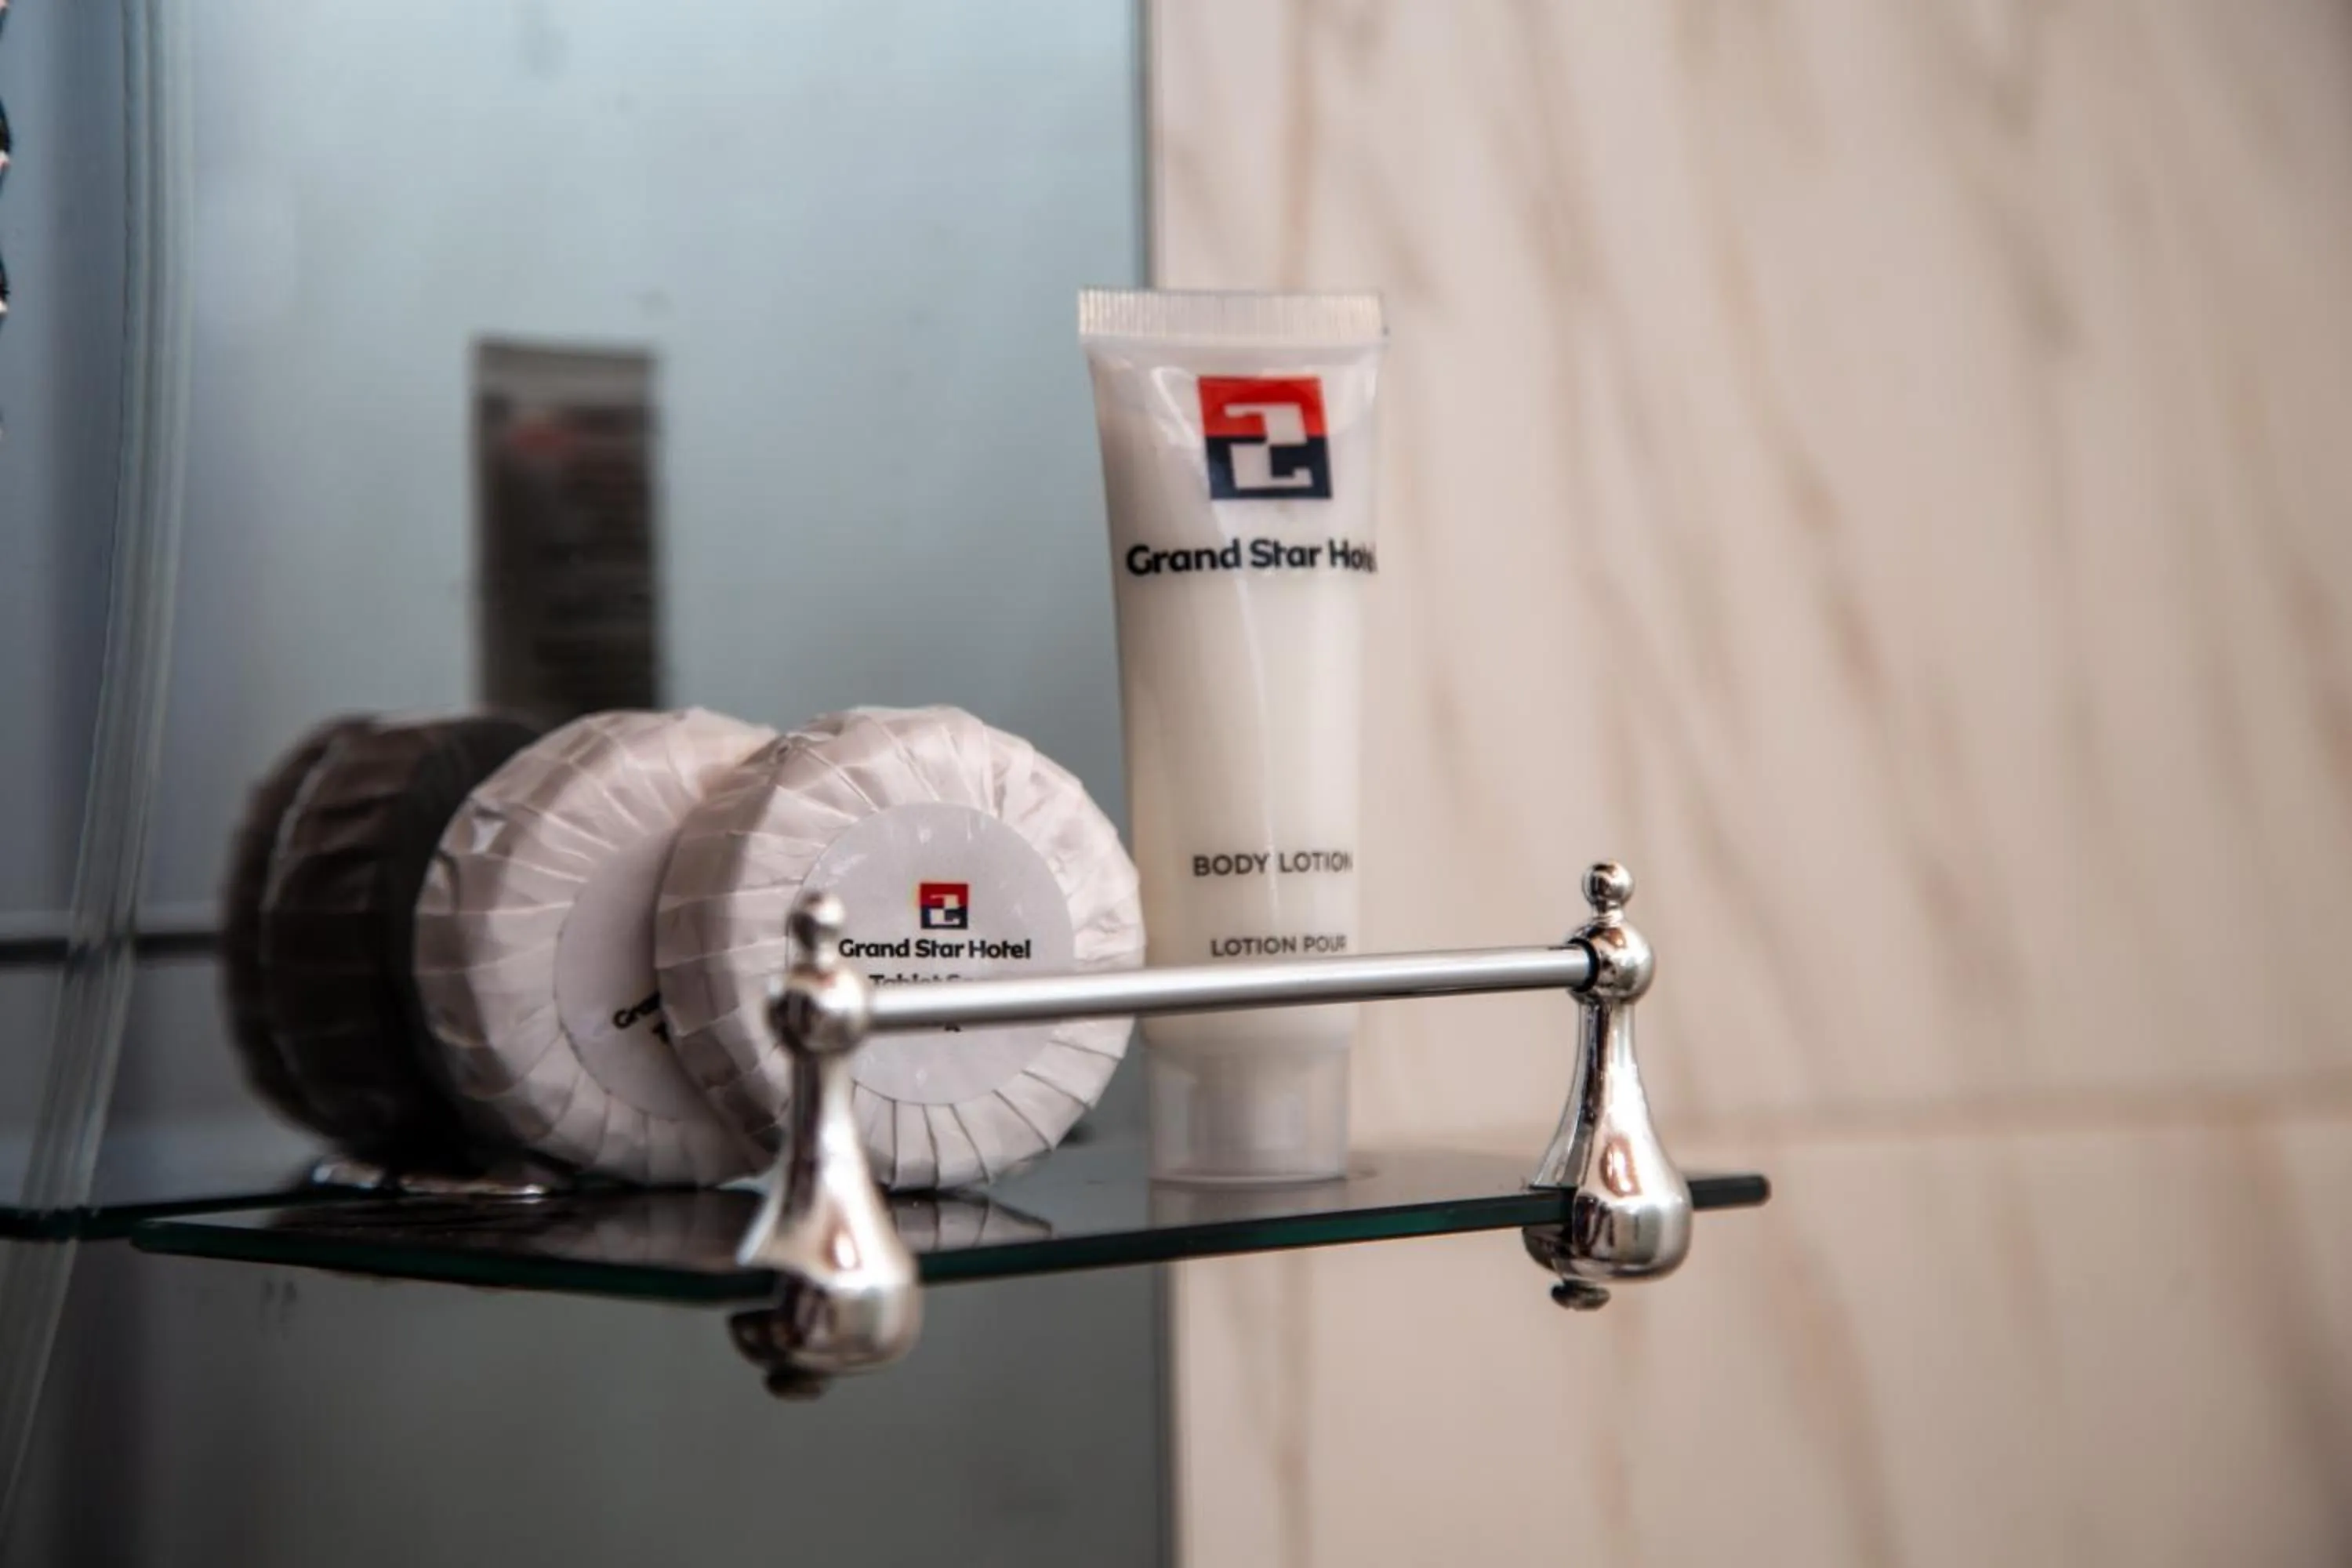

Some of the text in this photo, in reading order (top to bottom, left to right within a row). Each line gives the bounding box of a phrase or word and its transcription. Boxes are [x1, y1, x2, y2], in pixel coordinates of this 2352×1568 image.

[1126, 539, 1241, 575] Grand
[1250, 539, 1322, 568] Star
[1192, 851, 1353, 877] BODY LOTION
[838, 938, 1031, 959] Grand Star Hotel
[1210, 937, 1297, 957] LOTION
